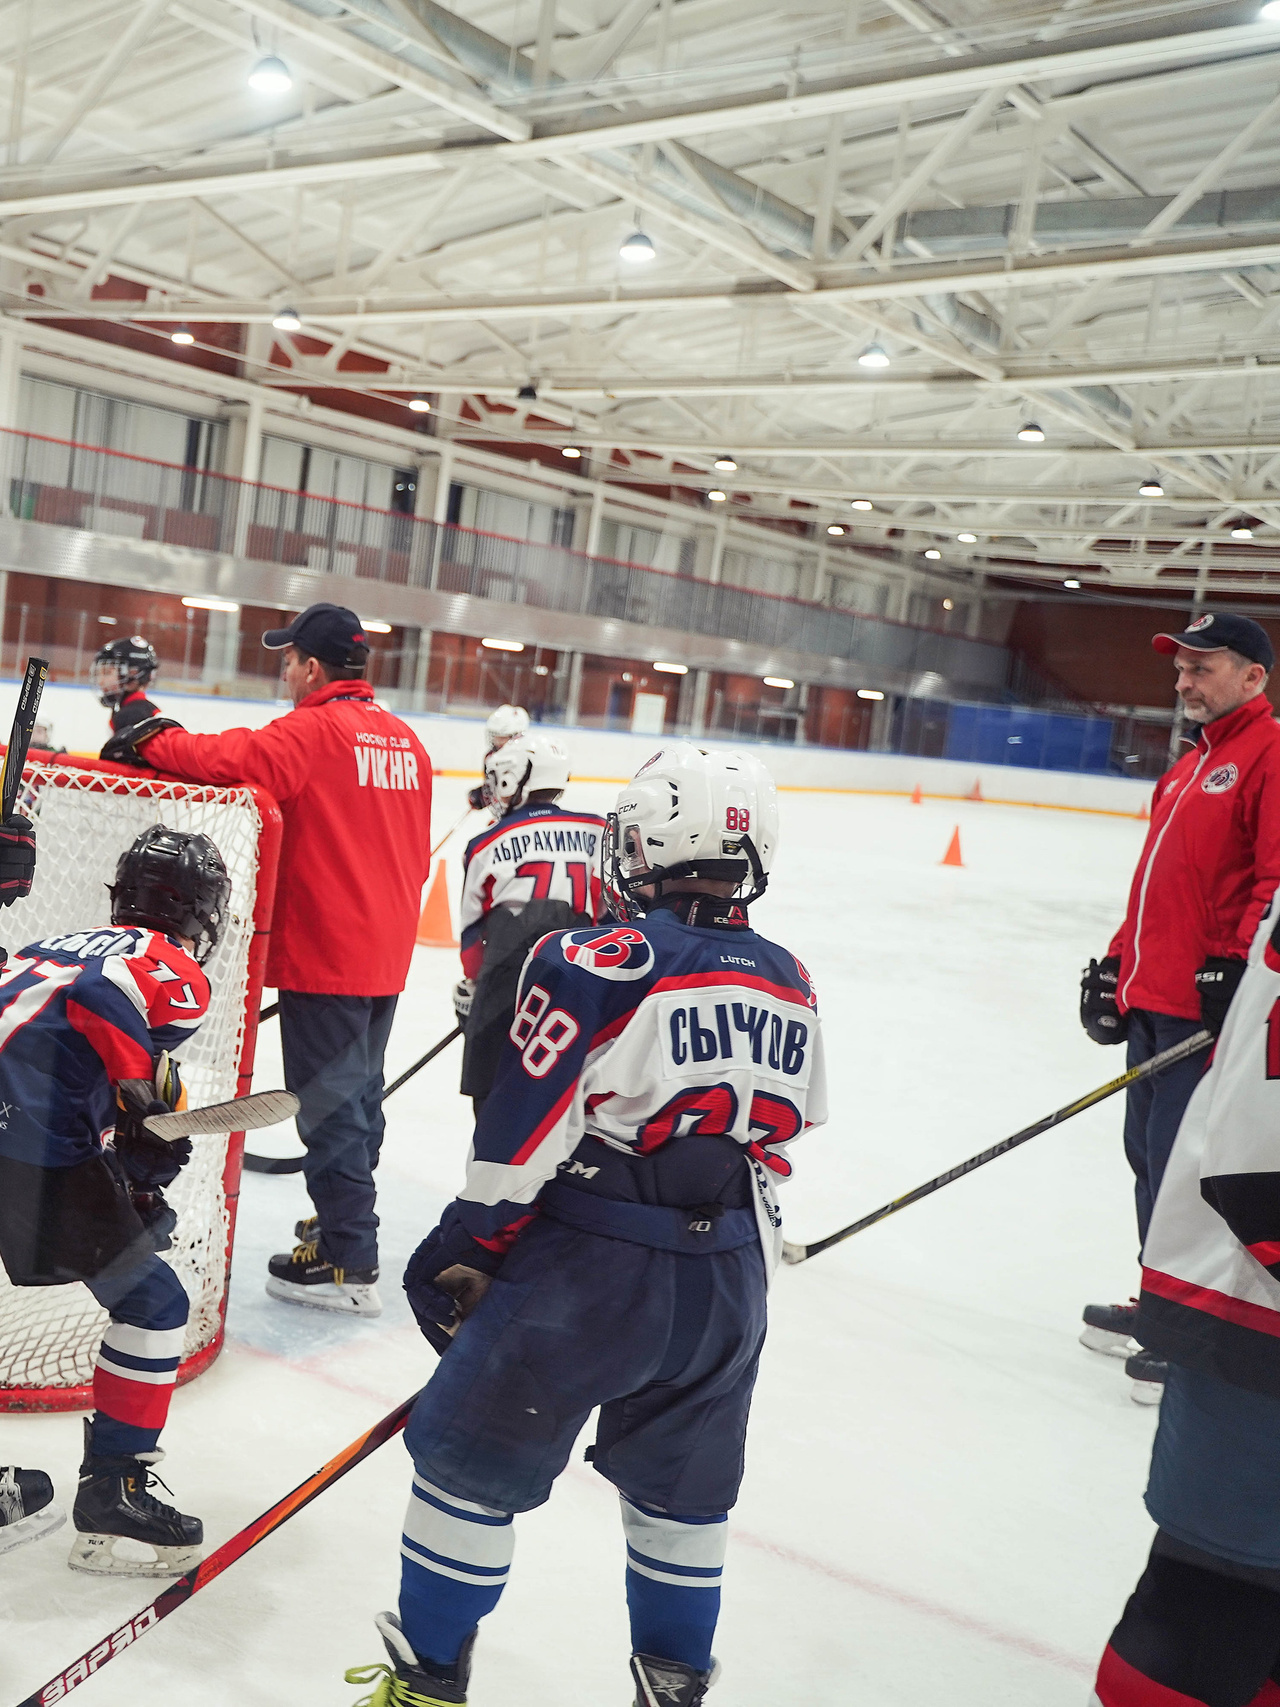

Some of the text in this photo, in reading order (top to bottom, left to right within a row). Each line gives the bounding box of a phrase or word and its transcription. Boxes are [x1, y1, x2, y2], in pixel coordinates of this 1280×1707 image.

[354, 745, 420, 790] VIKHR
[618, 803, 638, 815] CCM
[726, 806, 750, 832] 88
[628, 880, 644, 889] CCM
[720, 955, 756, 968] LUTCH
[146, 959, 202, 1010] 77
[509, 983, 581, 1080] 88
